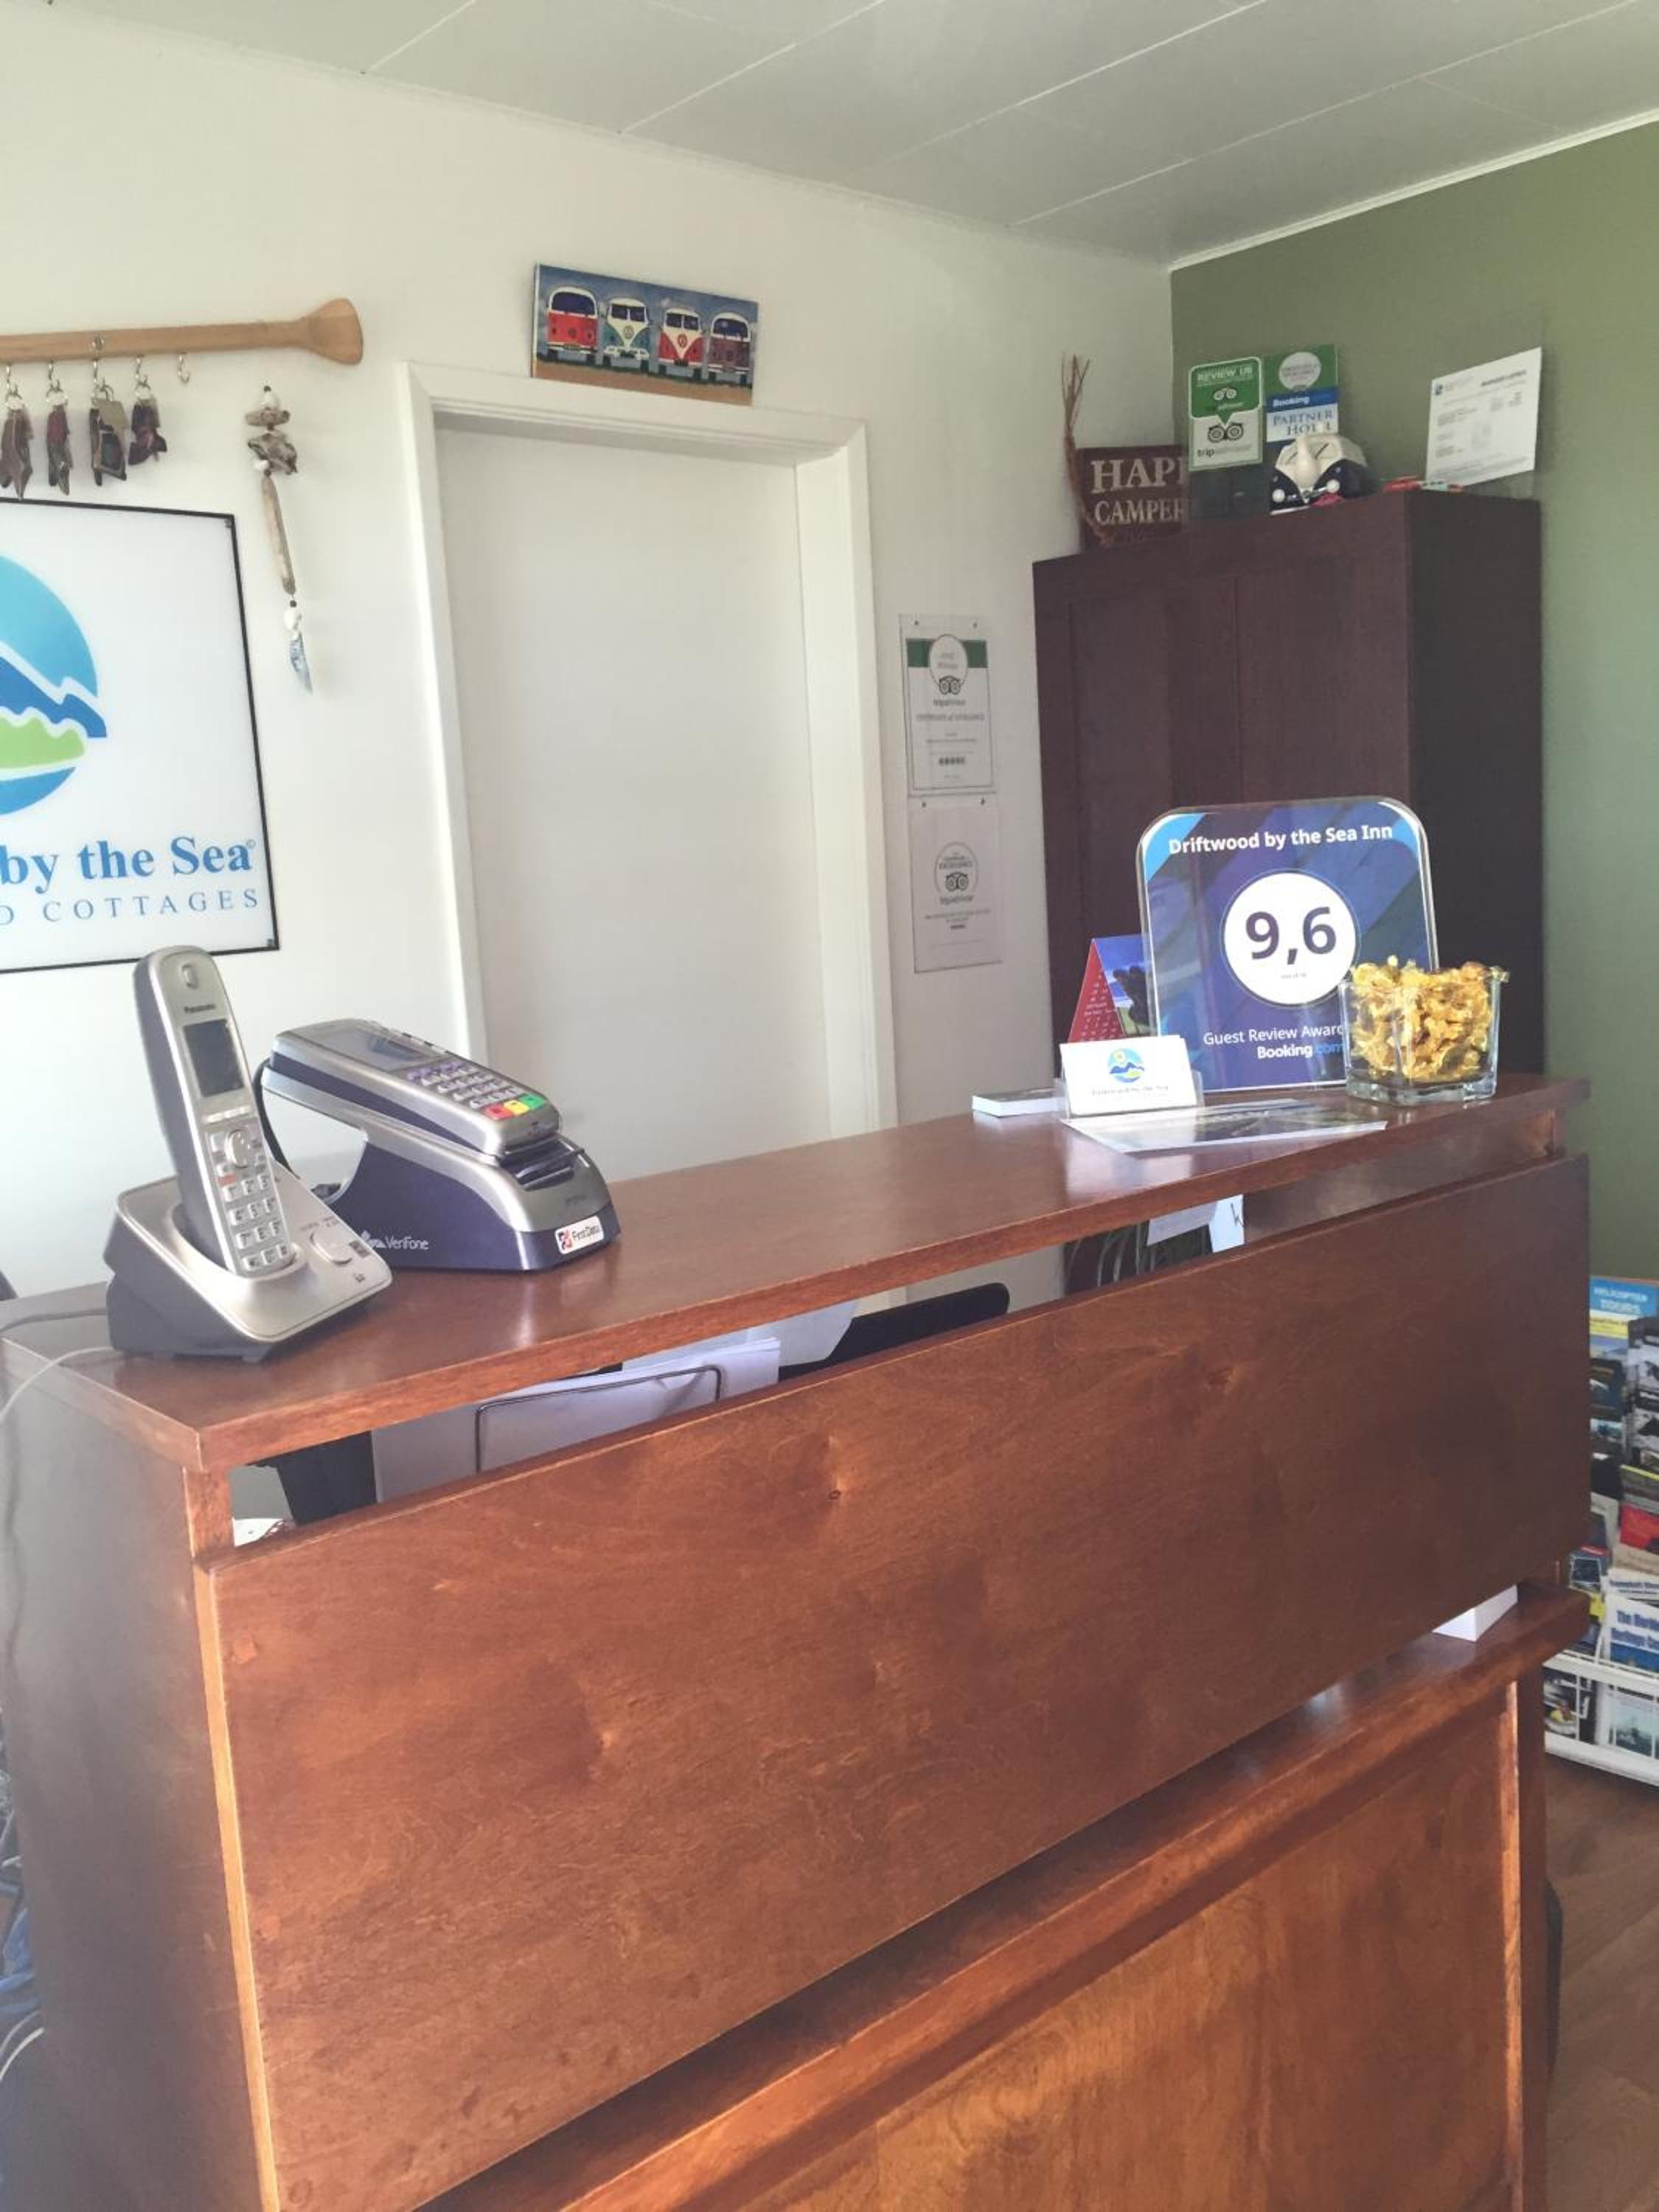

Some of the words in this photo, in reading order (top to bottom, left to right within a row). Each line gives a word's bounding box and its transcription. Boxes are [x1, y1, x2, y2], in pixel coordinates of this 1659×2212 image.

[1273, 409, 1333, 426] PARTNER
[1168, 832, 1259, 854] Driftwood
[1265, 831, 1286, 849] by
[1290, 829, 1321, 845] the
[1325, 827, 1357, 843] Sea
[1362, 824, 1393, 840] Inn
[0, 844, 59, 894] by
[77, 840, 155, 880] the
[42, 888, 258, 922] COTTAGES
[1245, 906, 1337, 965] 9,6
[1203, 1031, 1245, 1045] Guest
[1249, 1028, 1298, 1042] Review
